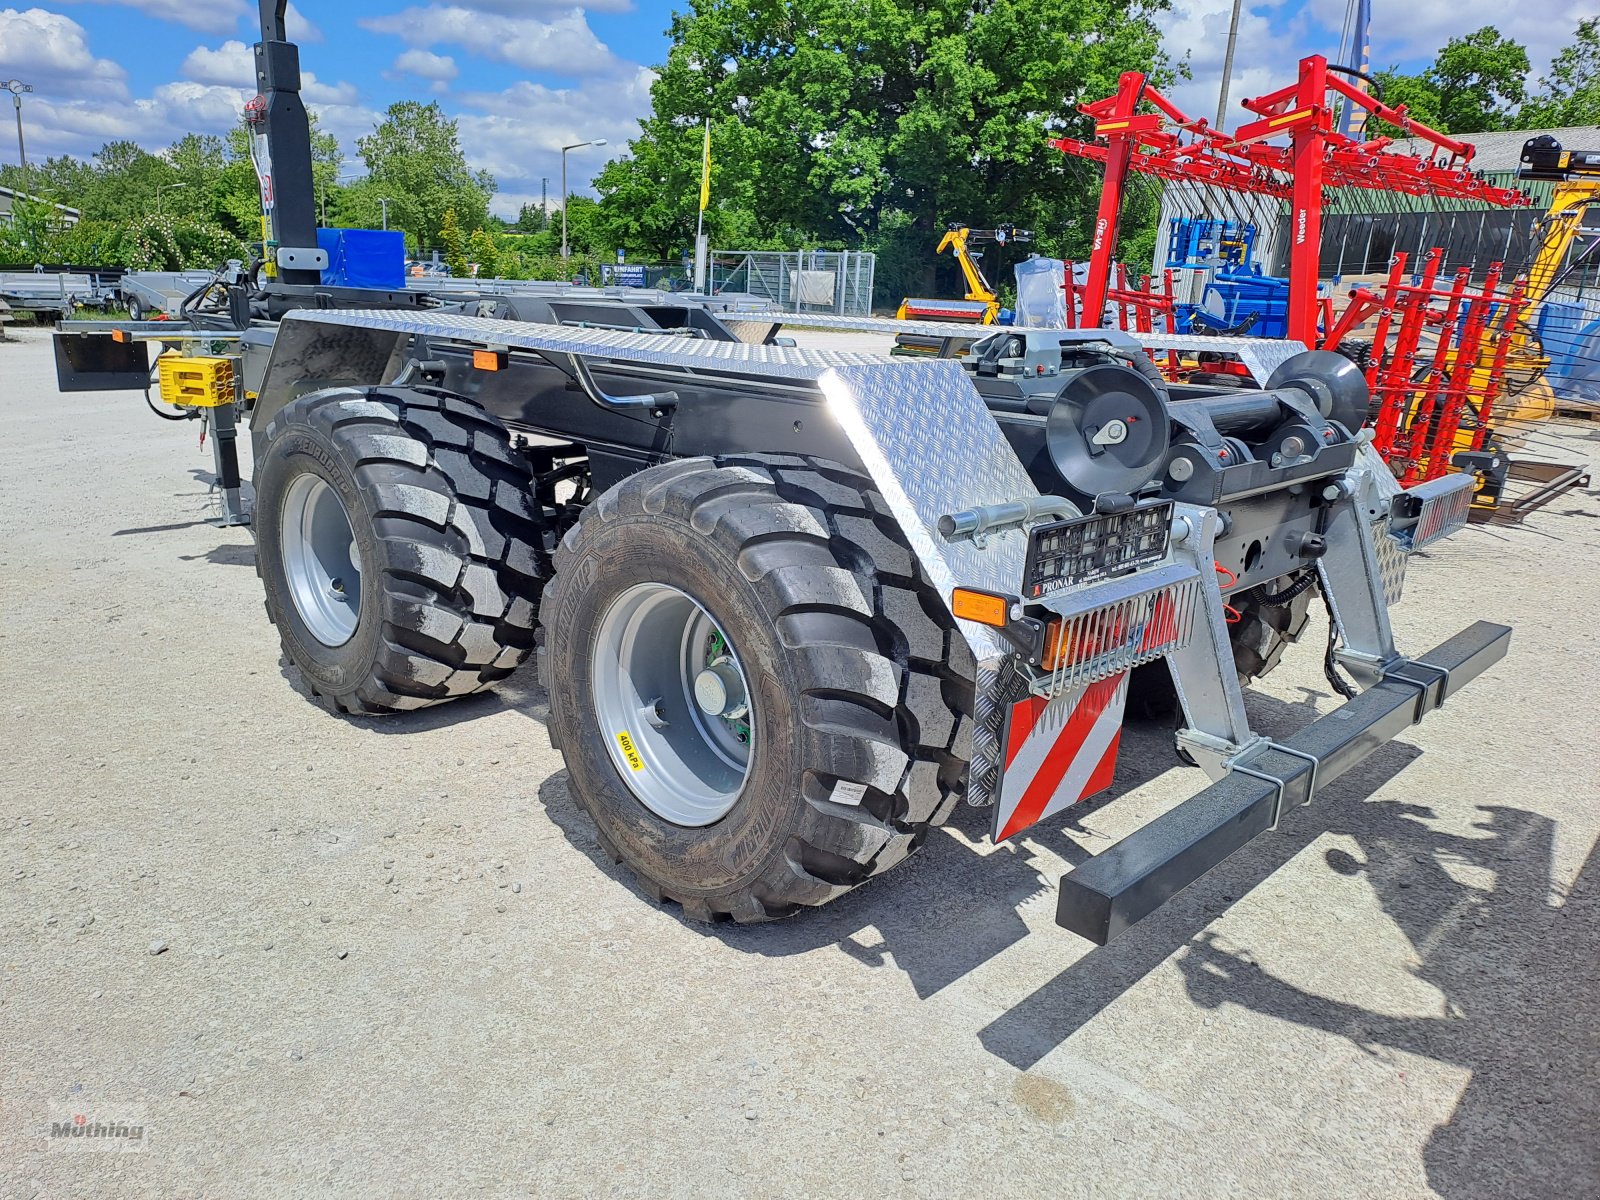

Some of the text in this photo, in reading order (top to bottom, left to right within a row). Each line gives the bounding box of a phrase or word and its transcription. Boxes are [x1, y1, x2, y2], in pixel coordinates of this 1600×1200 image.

[1094, 219, 1107, 250] HE-VA
[1296, 208, 1306, 245] Weeder
[1042, 577, 1074, 593] PRONAR
[620, 735, 639, 768] 400 kPa
